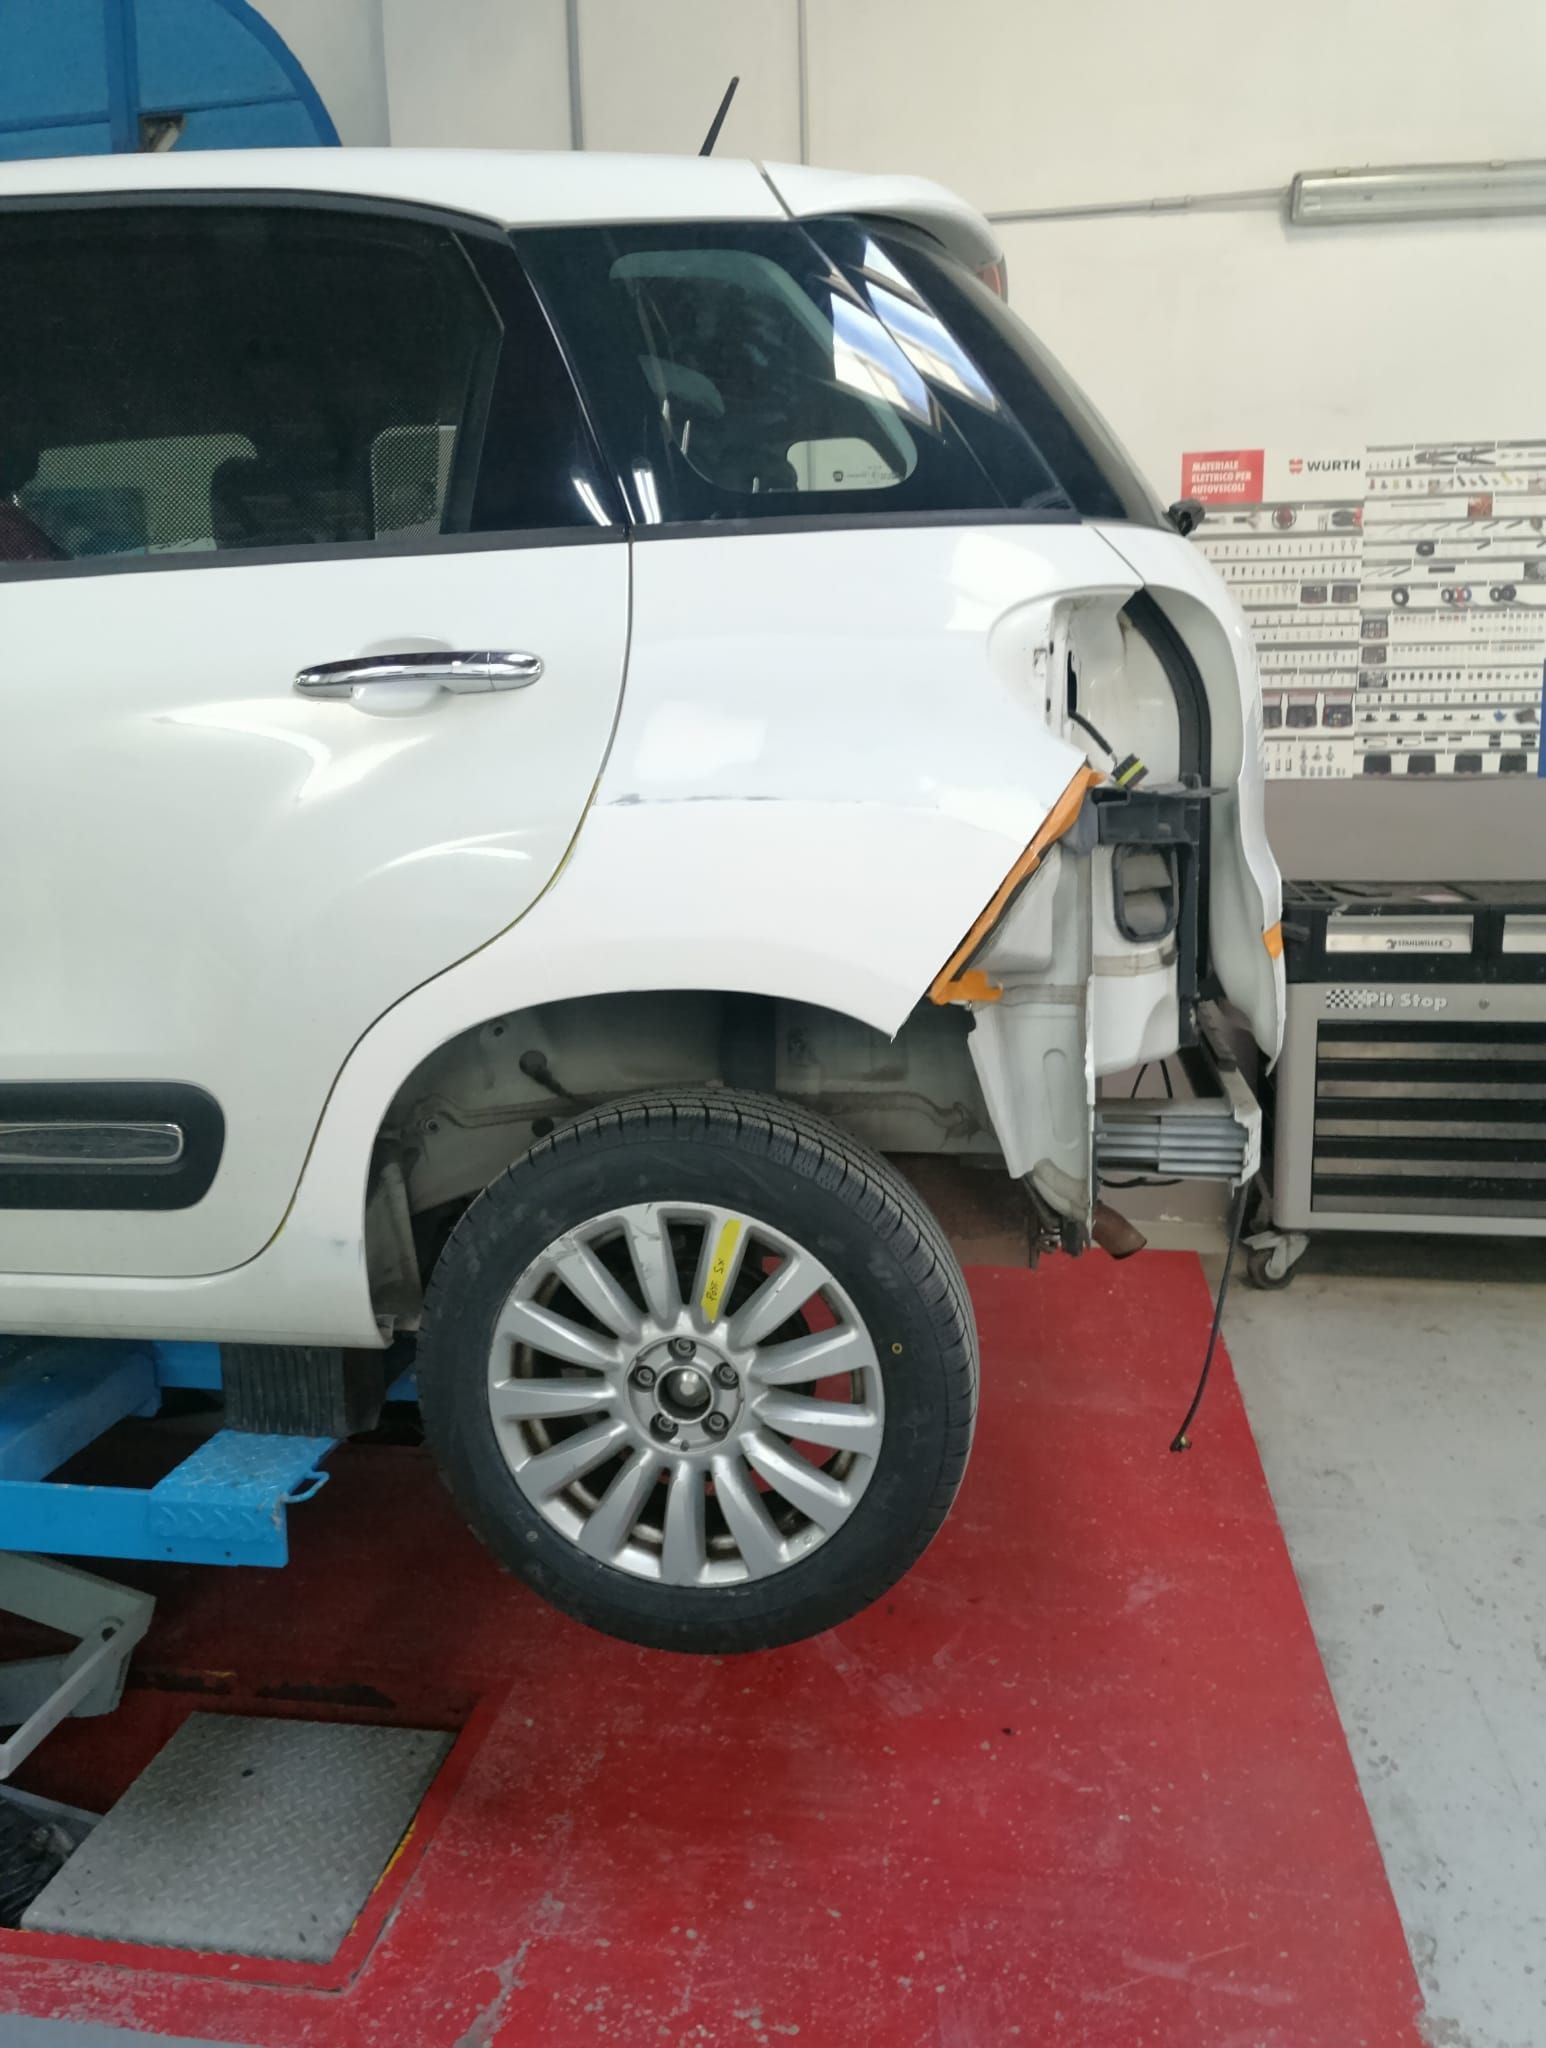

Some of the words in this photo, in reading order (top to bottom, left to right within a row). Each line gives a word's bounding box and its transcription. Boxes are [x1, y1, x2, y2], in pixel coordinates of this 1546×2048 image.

[1192, 460, 1239, 472] MATERIALE
[1191, 471, 1234, 483] ELETTRICO
[1235, 470, 1252, 481] PER
[1191, 482, 1245, 494] AUTOVEICOLI
[1365, 992, 1395, 1008] Pit
[1400, 993, 1448, 1012] Stop
